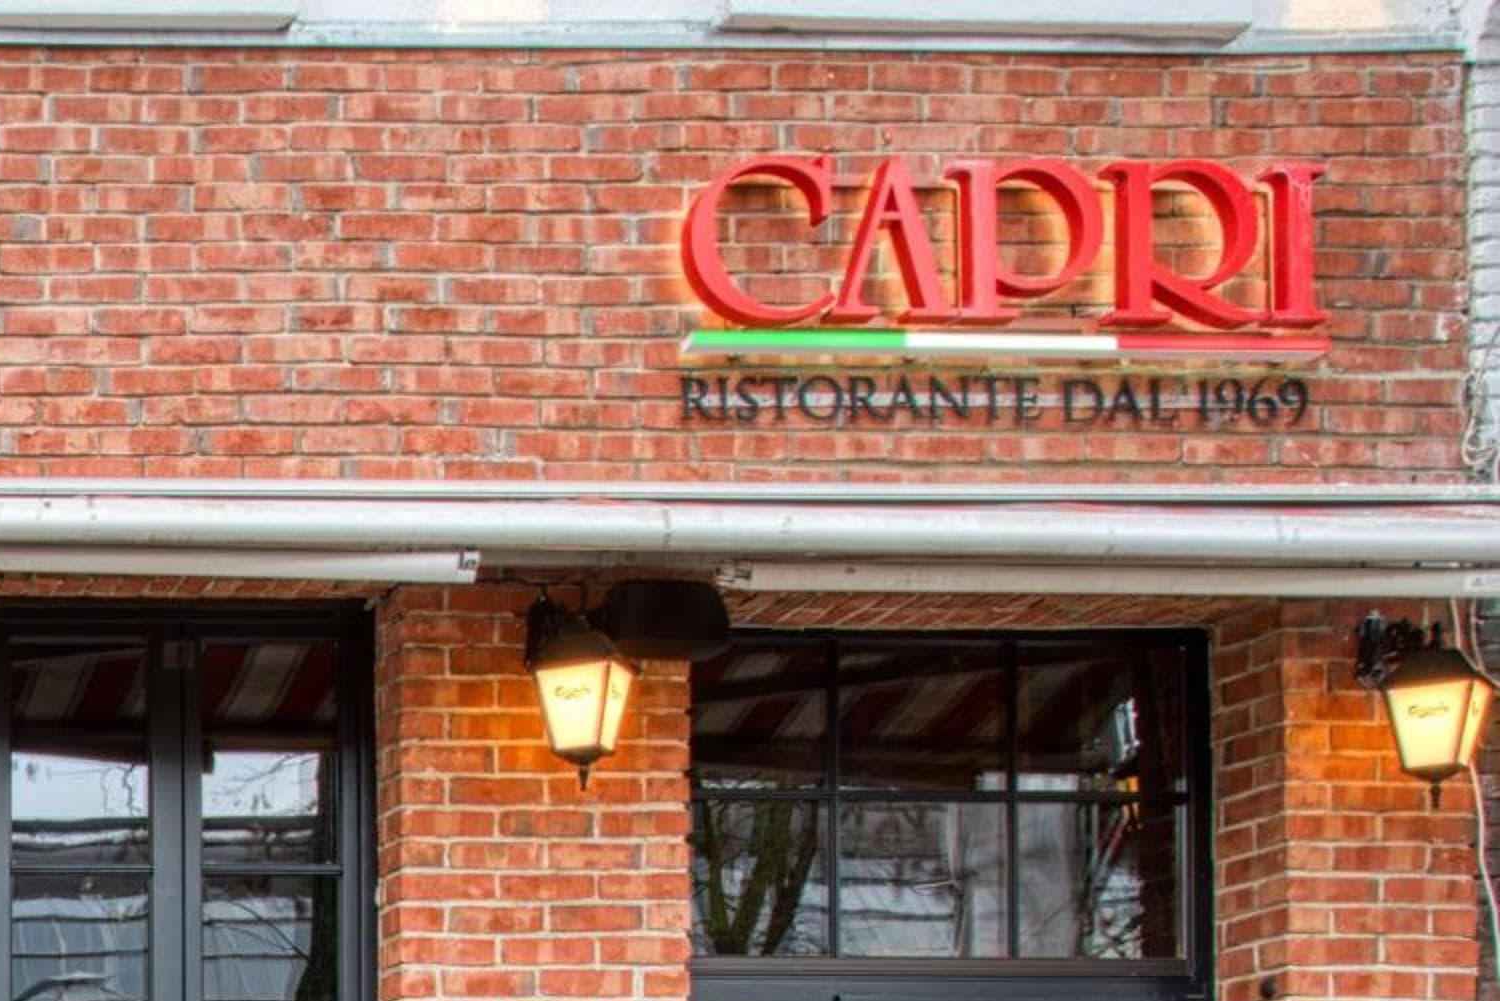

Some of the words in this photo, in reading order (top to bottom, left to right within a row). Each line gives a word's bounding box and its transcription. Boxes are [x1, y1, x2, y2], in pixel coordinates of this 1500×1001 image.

[680, 155, 1329, 331] CAPRI
[680, 374, 1042, 424] RISTORANTE
[1063, 377, 1175, 424] DAL
[1196, 376, 1310, 427] 1969
